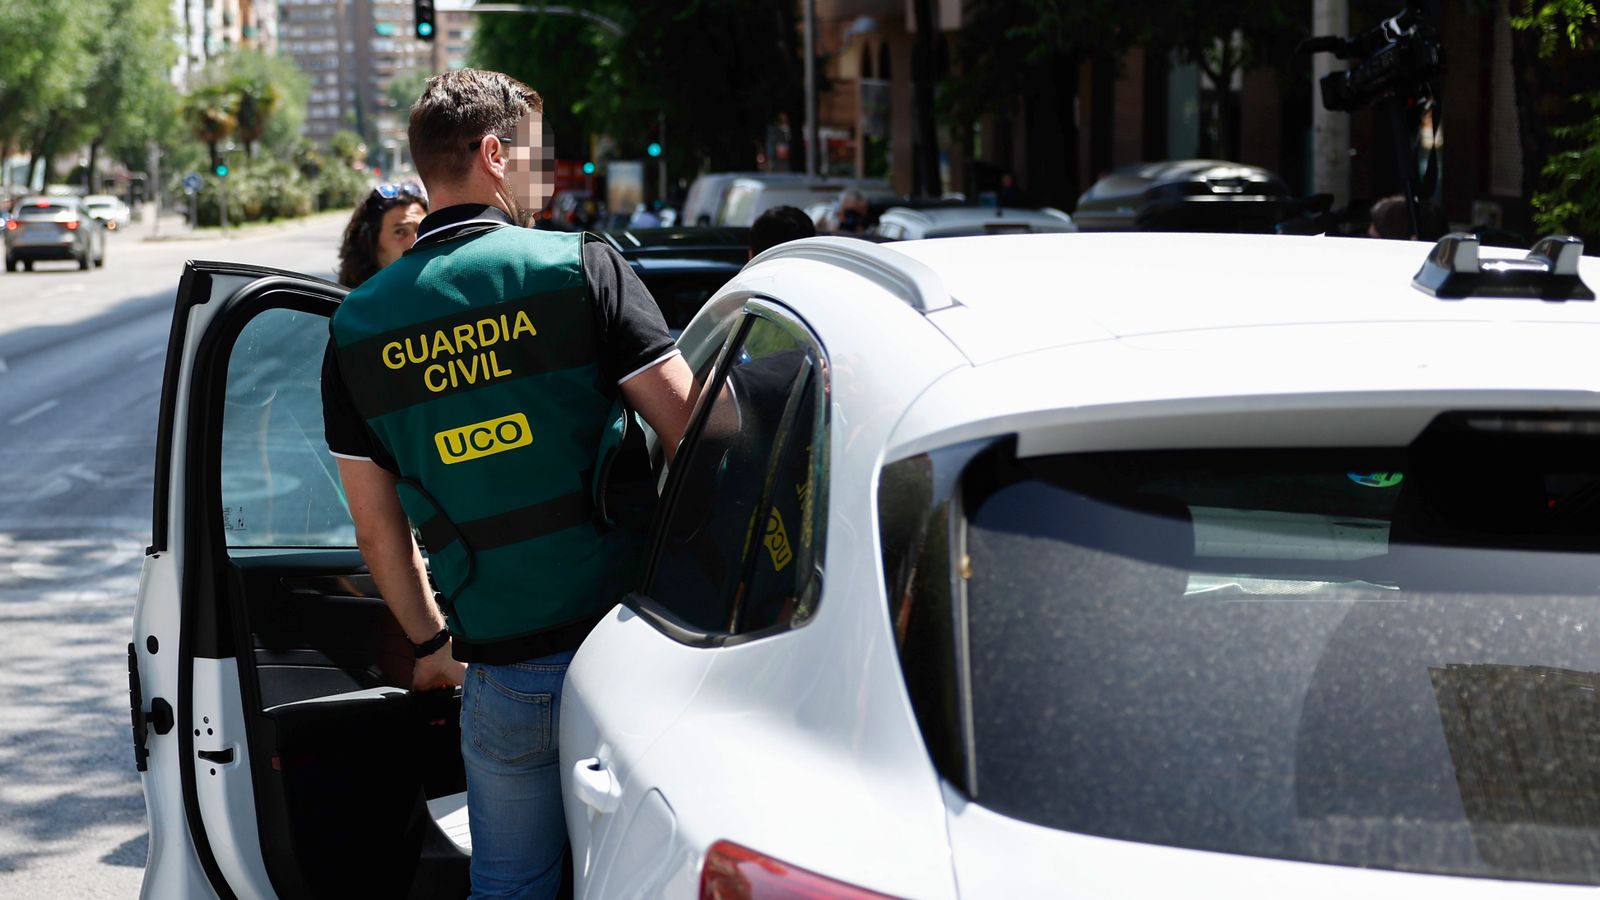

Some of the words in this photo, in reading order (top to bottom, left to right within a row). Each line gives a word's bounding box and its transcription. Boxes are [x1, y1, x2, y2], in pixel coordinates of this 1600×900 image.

[382, 310, 537, 370] GUARDIA
[424, 350, 512, 392] CIVIL
[442, 420, 523, 458] UCO
